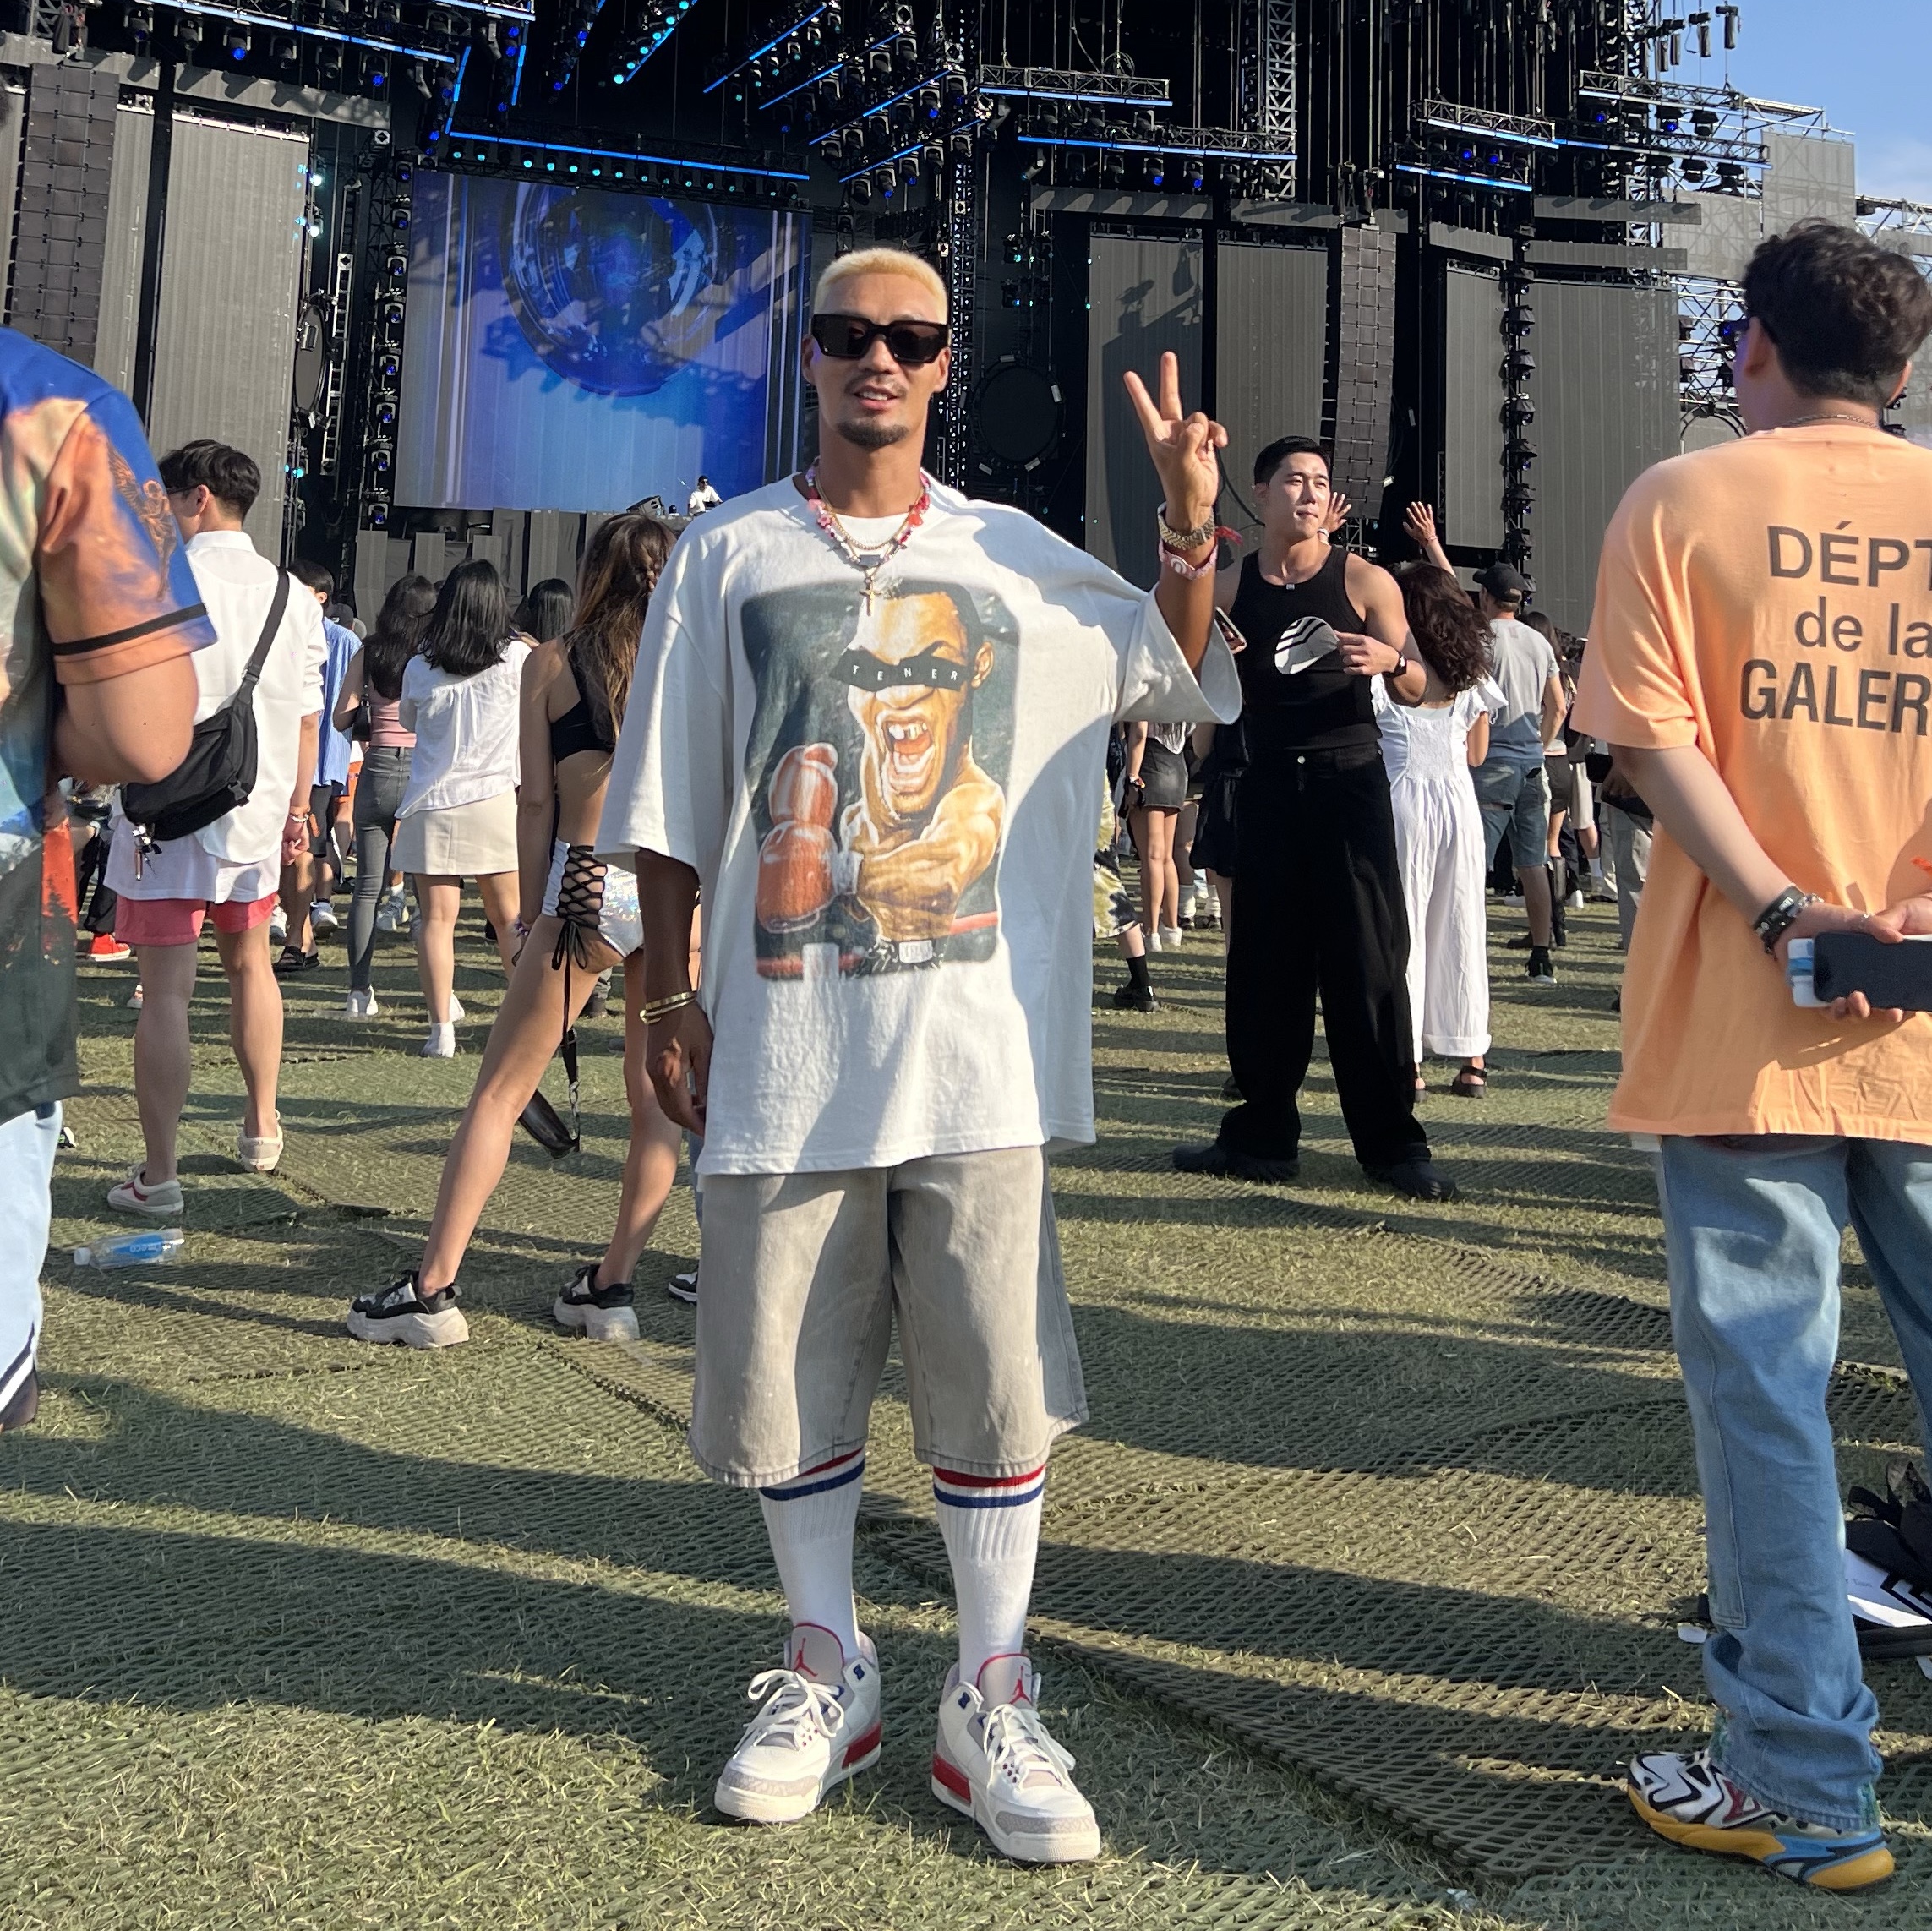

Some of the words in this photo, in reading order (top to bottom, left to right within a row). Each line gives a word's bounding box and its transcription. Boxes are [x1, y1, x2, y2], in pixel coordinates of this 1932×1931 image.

[1795, 595, 1863, 652] de
[1888, 603, 1932, 658] la
[853, 664, 958, 680] TENER
[1739, 659, 1932, 737] GALER
